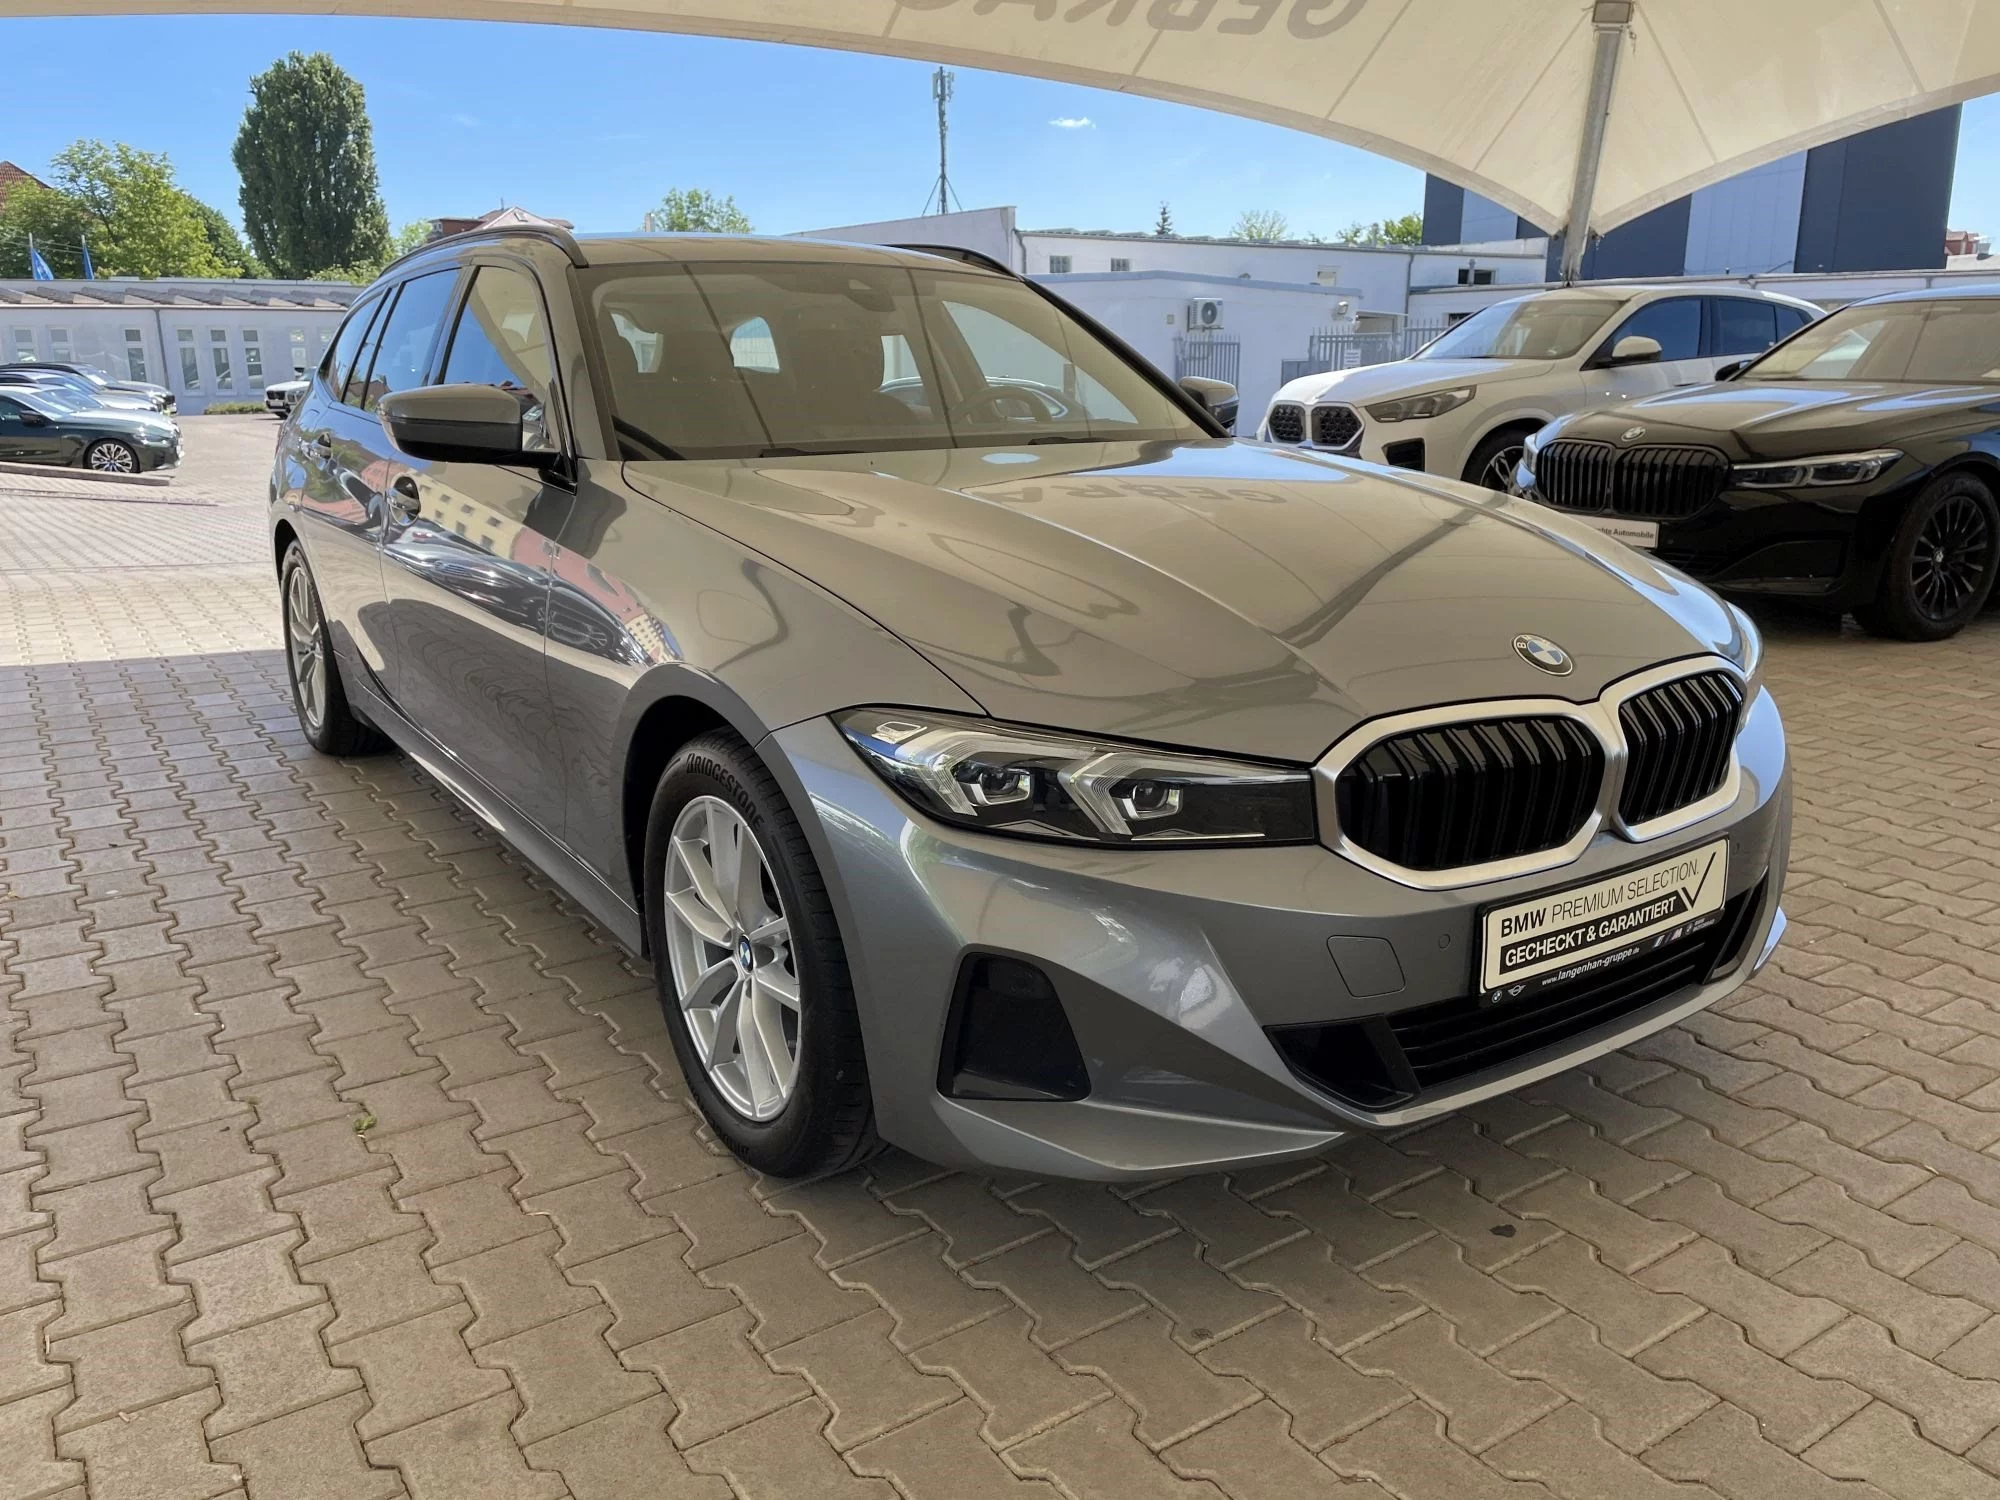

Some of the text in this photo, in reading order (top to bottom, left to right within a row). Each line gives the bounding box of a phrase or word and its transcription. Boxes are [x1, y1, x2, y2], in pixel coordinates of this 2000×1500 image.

[686, 752, 765, 831] BRIDGESTONE
[1501, 907, 1547, 938] BMW
[1551, 885, 1625, 924] PREMIUM
[1505, 896, 1678, 967] GECHECKT & GARANTIERT
[1541, 946, 1640, 986] www.langenhan-gruppe.de
